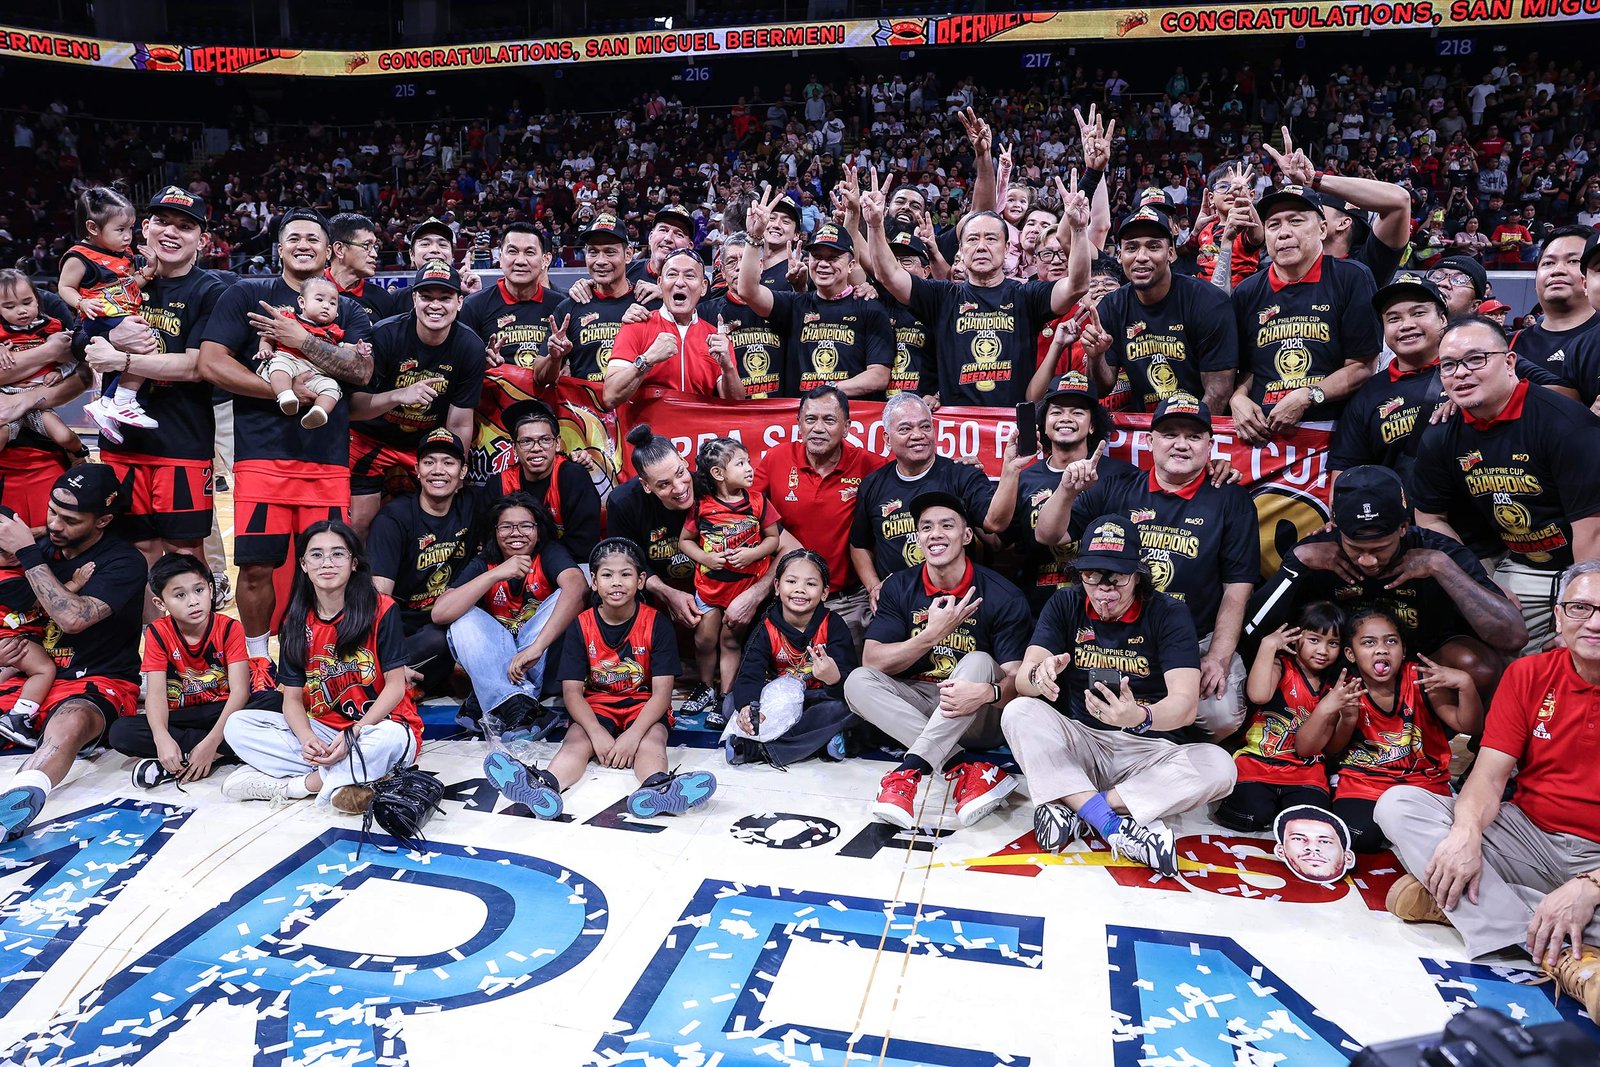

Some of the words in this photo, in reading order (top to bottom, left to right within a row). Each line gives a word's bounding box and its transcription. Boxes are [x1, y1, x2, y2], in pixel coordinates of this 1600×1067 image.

[1161, 1, 1443, 33] CONGRATULATIONS,
[1450, 0, 1513, 21] SAN
[378, 40, 579, 70] CONGRATULATIONS,
[586, 37, 629, 58] SAN
[638, 32, 721, 55] MIGUEL
[726, 26, 846, 49] BEERMEN!
[1440, 39, 1472, 55] 218
[1026, 53, 1051, 68] 217
[685, 68, 710, 82] 216
[395, 85, 415, 98] 215
[956, 316, 1015, 335] CHAMPIONS
[1277, 316, 1308, 324] PHILIPPINE
[801, 327, 855, 346] CHAMPIONS
[977, 329, 996, 339] 2026
[1257, 323, 1330, 347] CHAMPIONS
[519, 341, 537, 350] 2026
[746, 344, 764, 353] 2026
[818, 340, 835, 349] 2026
[1281, 338, 1303, 350] 2026
[961, 363, 977, 373] SAN
[977, 360, 1012, 371] MIGUEL
[755, 373, 780, 384] MIGUEL
[802, 373, 818, 382] SAN
[819, 371, 849, 381] MIGUEL
[959, 370, 1012, 385] BEERMEN
[1266, 380, 1284, 392] SAN
[1390, 414, 1401, 422] PBA
[1509, 467, 1525, 476] CUP
[1150, 525, 1179, 535] PHILIPPINE
[1180, 529, 1192, 537] CUP
[671, 553, 690, 566] 2026
[1147, 548, 1170, 562] 2026
[933, 645, 954, 657] 2026
[1083, 644, 1094, 652] PBA
[1125, 649, 1137, 657] CUP
[1074, 648, 1150, 678] CHAMPIONS
